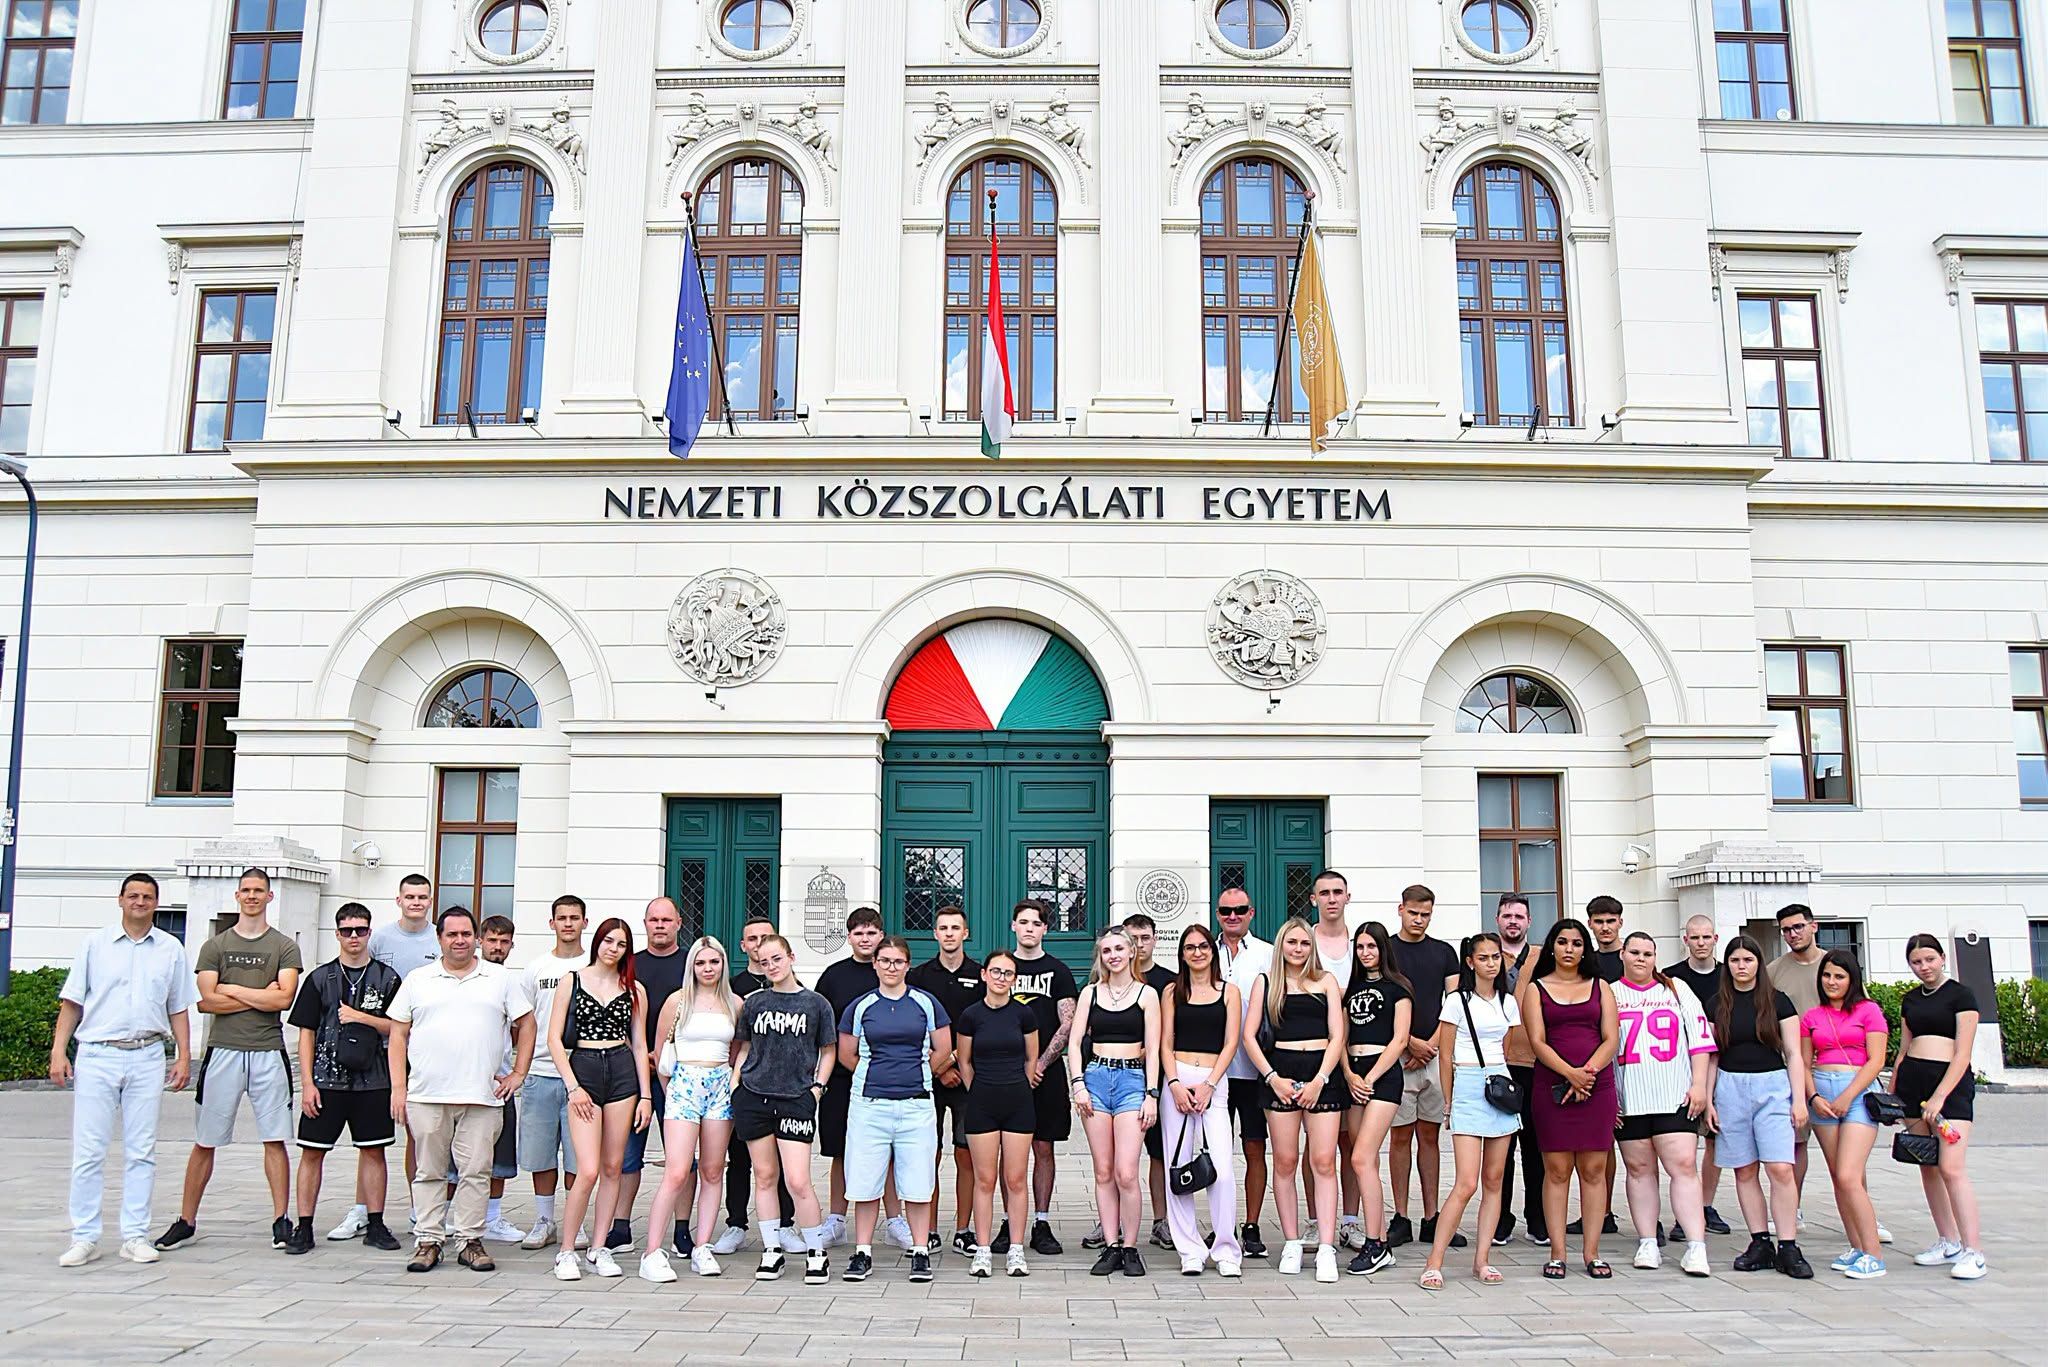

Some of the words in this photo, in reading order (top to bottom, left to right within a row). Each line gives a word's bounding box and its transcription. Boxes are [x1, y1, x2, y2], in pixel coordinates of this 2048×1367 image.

[603, 486, 783, 519] NEMZETI
[817, 476, 1165, 519] KÖZSZOLGÁLATI
[1202, 487, 1393, 520] EGYETEM
[550, 978, 561, 989] LA
[1008, 971, 1055, 998] ERLAST
[1350, 997, 1375, 1014] NY
[753, 1010, 807, 1037] KARMA
[1617, 1009, 1679, 1066] 79
[780, 1117, 814, 1136] KARMA
